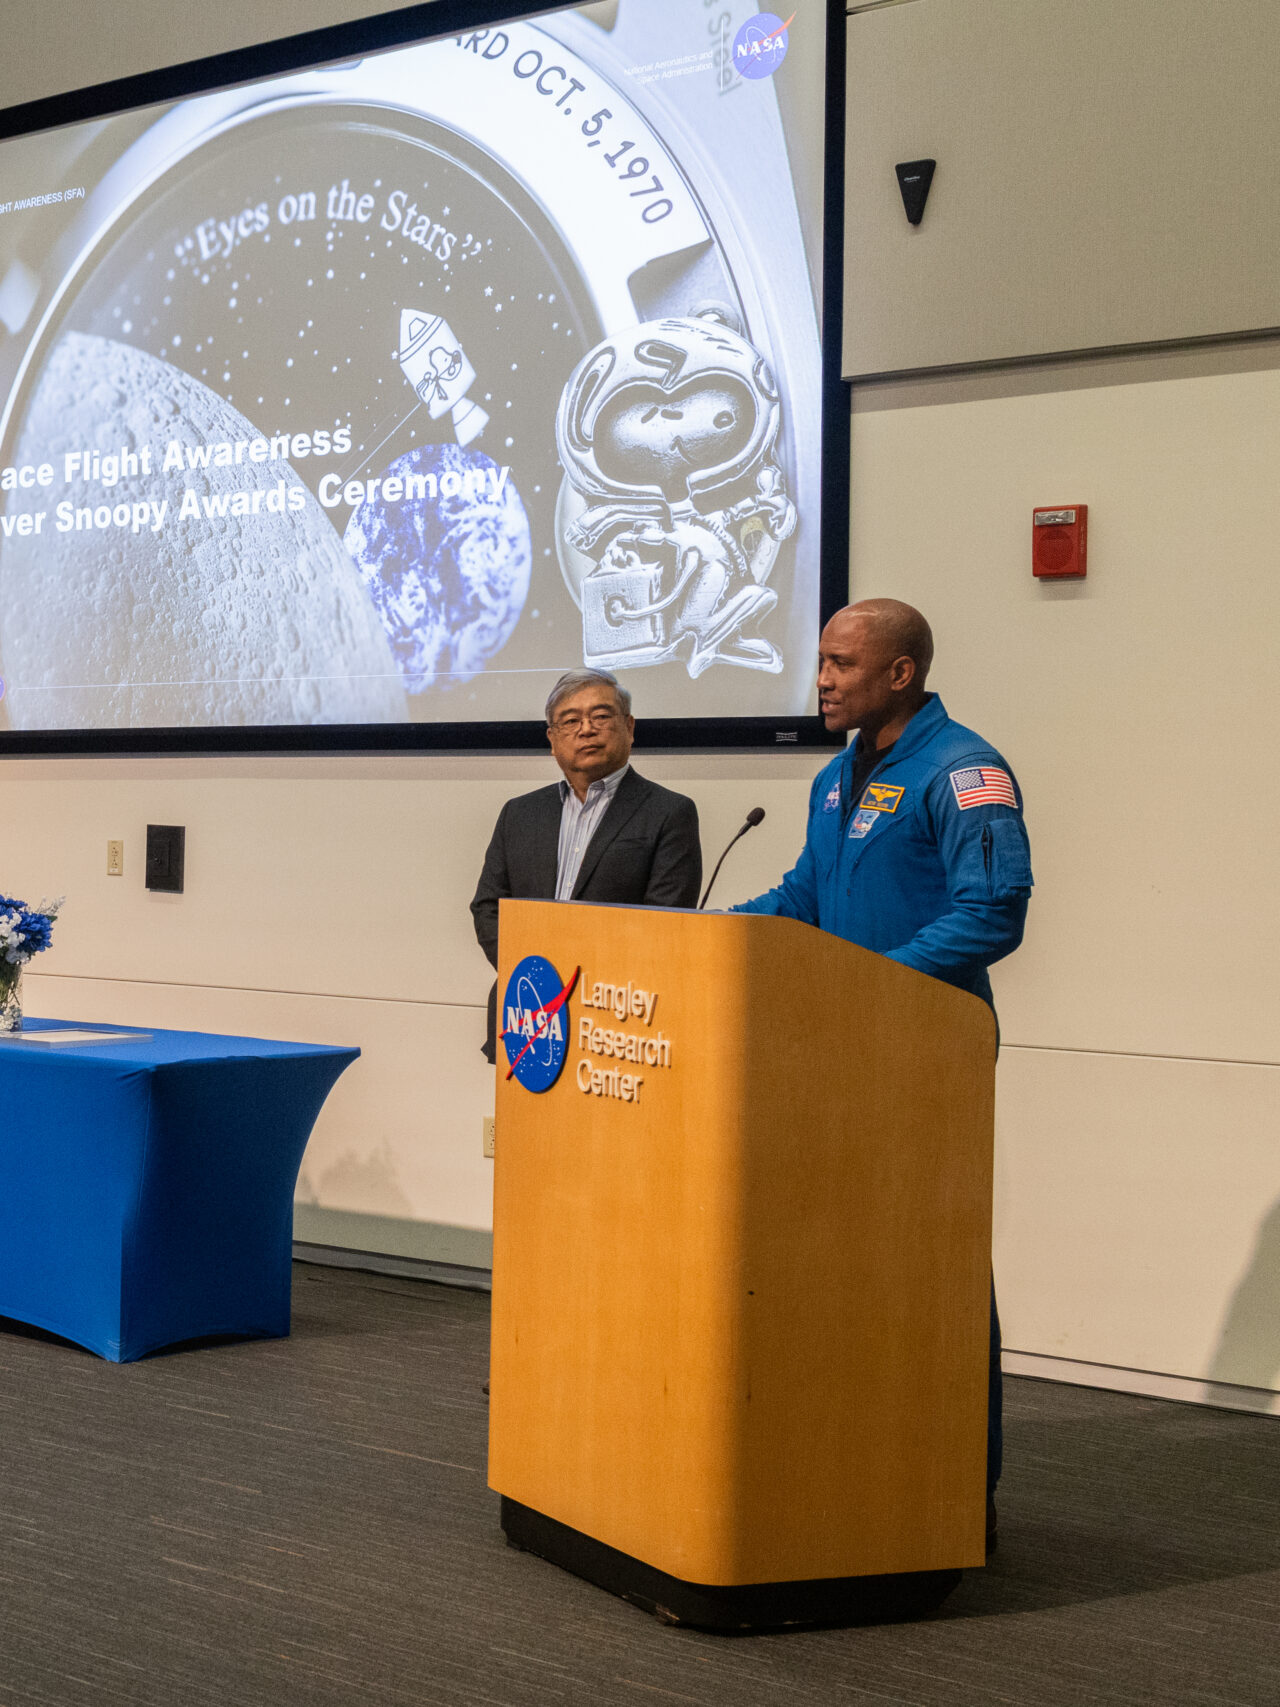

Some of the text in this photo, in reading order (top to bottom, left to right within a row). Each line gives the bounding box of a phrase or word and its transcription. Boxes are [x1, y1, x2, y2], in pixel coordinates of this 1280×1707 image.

[699, 49, 713, 61] and
[737, 35, 785, 58] NASA
[513, 50, 586, 115] OCT.
[662, 62, 713, 79] Administration
[14, 191, 63, 211] AWARENESS
[64, 187, 86, 202] (SFA)
[278, 191, 317, 225] on
[326, 178, 375, 223] the
[64, 446, 152, 487] Flight
[162, 427, 352, 473] Awareness
[55, 499, 168, 533] Snoopy
[178, 479, 306, 521] Awards
[318, 466, 510, 508] Ceremony
[580, 972, 658, 1026] Langley
[506, 1005, 564, 1042] NASA
[578, 1017, 672, 1068] Research
[576, 1058, 643, 1104] Center
